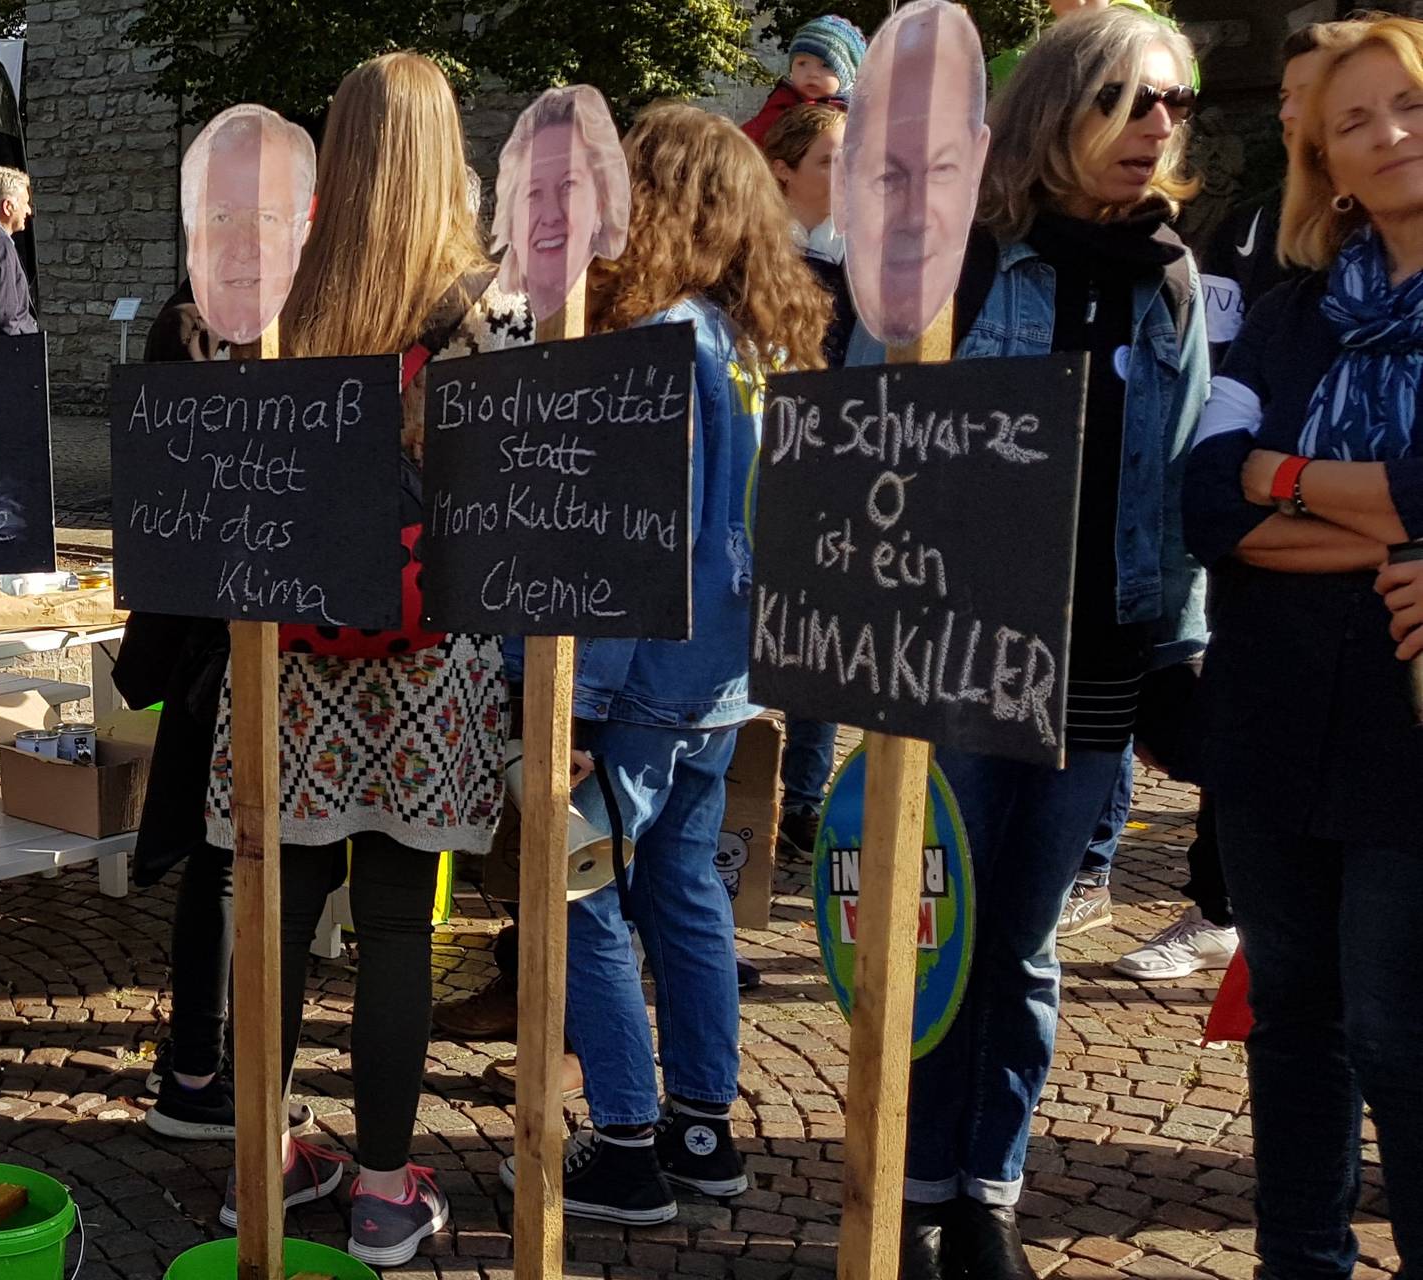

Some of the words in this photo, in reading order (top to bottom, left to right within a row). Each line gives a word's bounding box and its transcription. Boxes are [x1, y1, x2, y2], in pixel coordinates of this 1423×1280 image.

[129, 378, 363, 463] Augenmaß
[435, 365, 685, 430] Biodiversität
[769, 395, 826, 466] Die
[201, 439, 306, 495] rettet
[130, 489, 214, 542] nicht
[219, 504, 295, 552] das
[480, 555, 627, 617] Chemie
[814, 512, 857, 573] ist
[870, 531, 948, 598] ein
